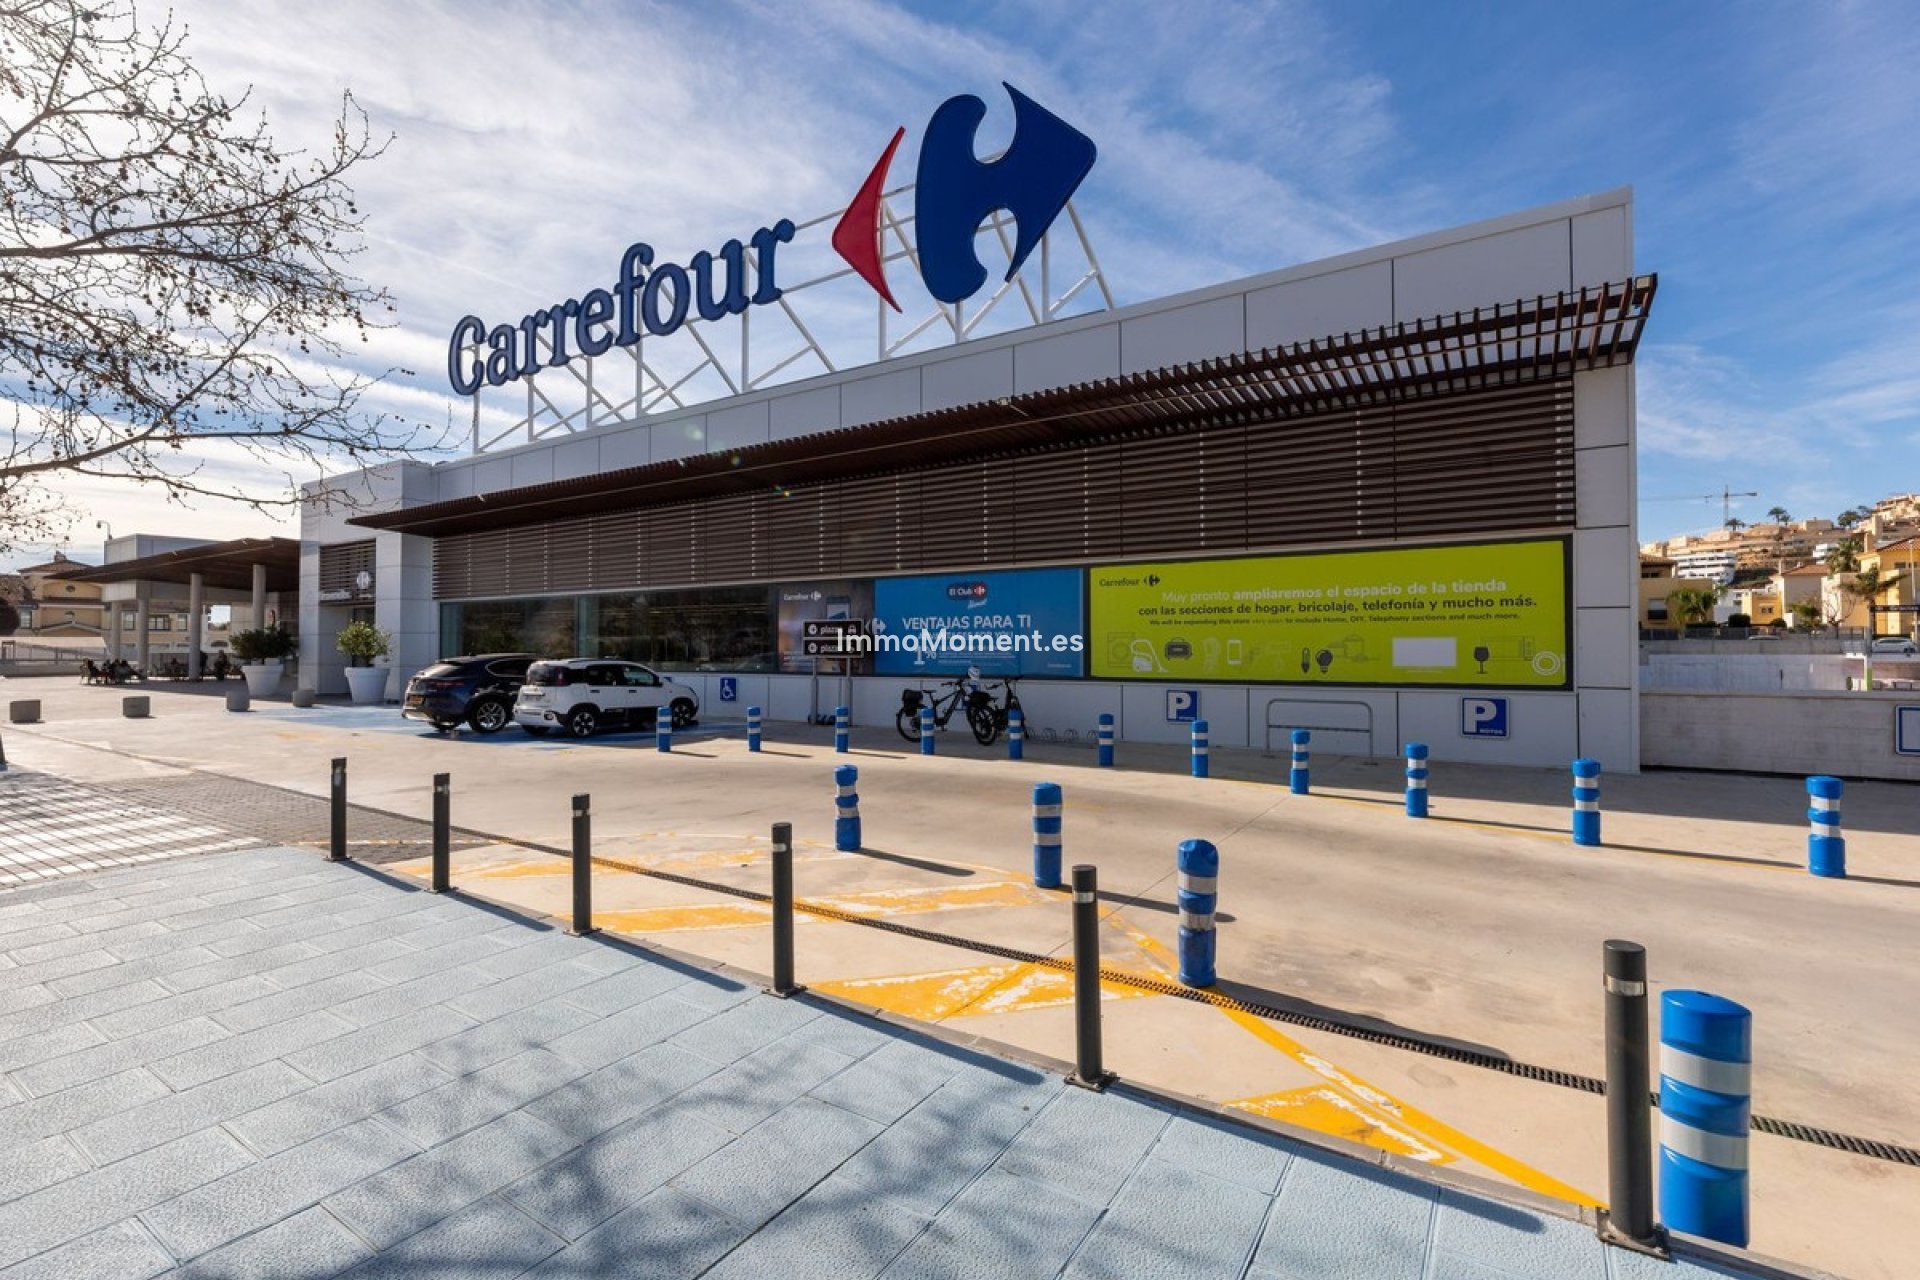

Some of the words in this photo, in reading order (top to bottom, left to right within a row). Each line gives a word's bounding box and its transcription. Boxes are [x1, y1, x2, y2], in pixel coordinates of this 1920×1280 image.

[449, 218, 796, 396] Carrefour
[1098, 577, 1140, 588] Carrefour
[1162, 591, 1186, 603] Muy
[1190, 590, 1230, 602] pronto
[1232, 586, 1322, 601] ampliaremos
[1327, 585, 1339, 598] el
[1343, 582, 1403, 599] espacio
[1407, 581, 1429, 595] de
[1432, 580, 1448, 594] la
[1451, 578, 1507, 593] tienda
[1138, 607, 1158, 616] con
[1160, 605, 1176, 615] las
[1178, 603, 1233, 615] secciones
[1236, 602, 1251, 614] de
[1255, 601, 1295, 615] hogar,
[1298, 600, 1358, 613] bricolaje,
[1362, 598, 1425, 611] telefonía
[1428, 599, 1438, 611] y
[1442, 596, 1495, 609] mucho
[1499, 594, 1537, 608] más.
[902, 616, 971, 630] VENTAJAS
[974, 615, 1014, 629] PARA
[1016, 614, 1032, 628] TI
[1167, 692, 1191, 720] P
[1463, 700, 1497, 733] P
